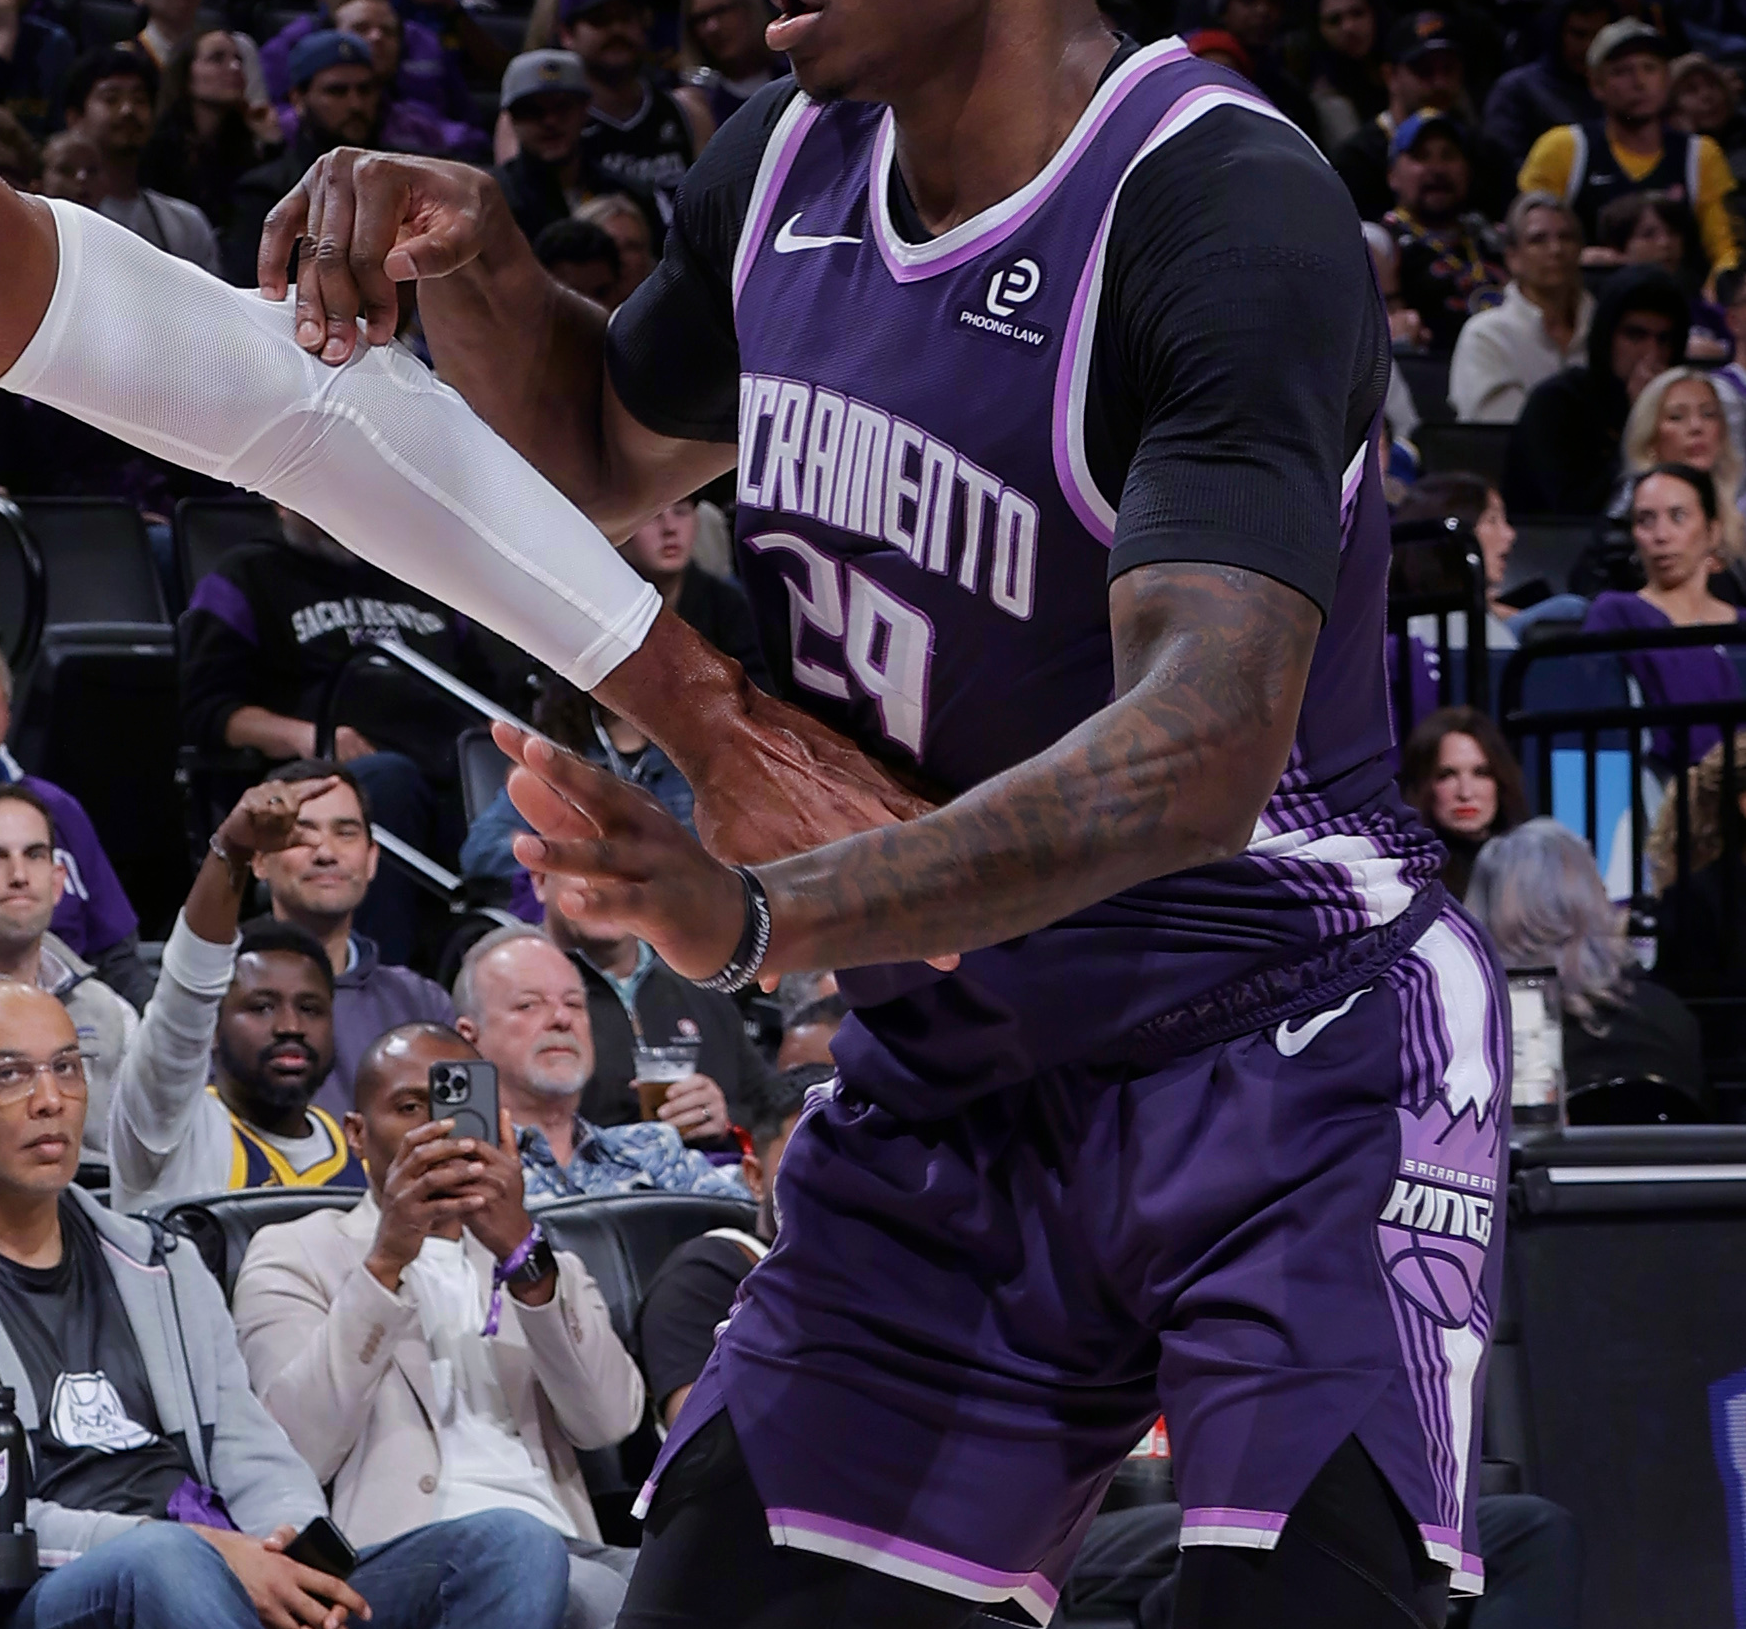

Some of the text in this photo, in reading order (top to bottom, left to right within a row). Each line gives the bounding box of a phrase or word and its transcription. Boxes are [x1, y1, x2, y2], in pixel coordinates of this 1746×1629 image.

[960, 310, 1044, 346] PHOONG LAW
[737, 372, 1040, 622] CRAMENTO
[744, 530, 935, 765] 29
[1404, 1158, 1497, 1192] SACRAMENT
